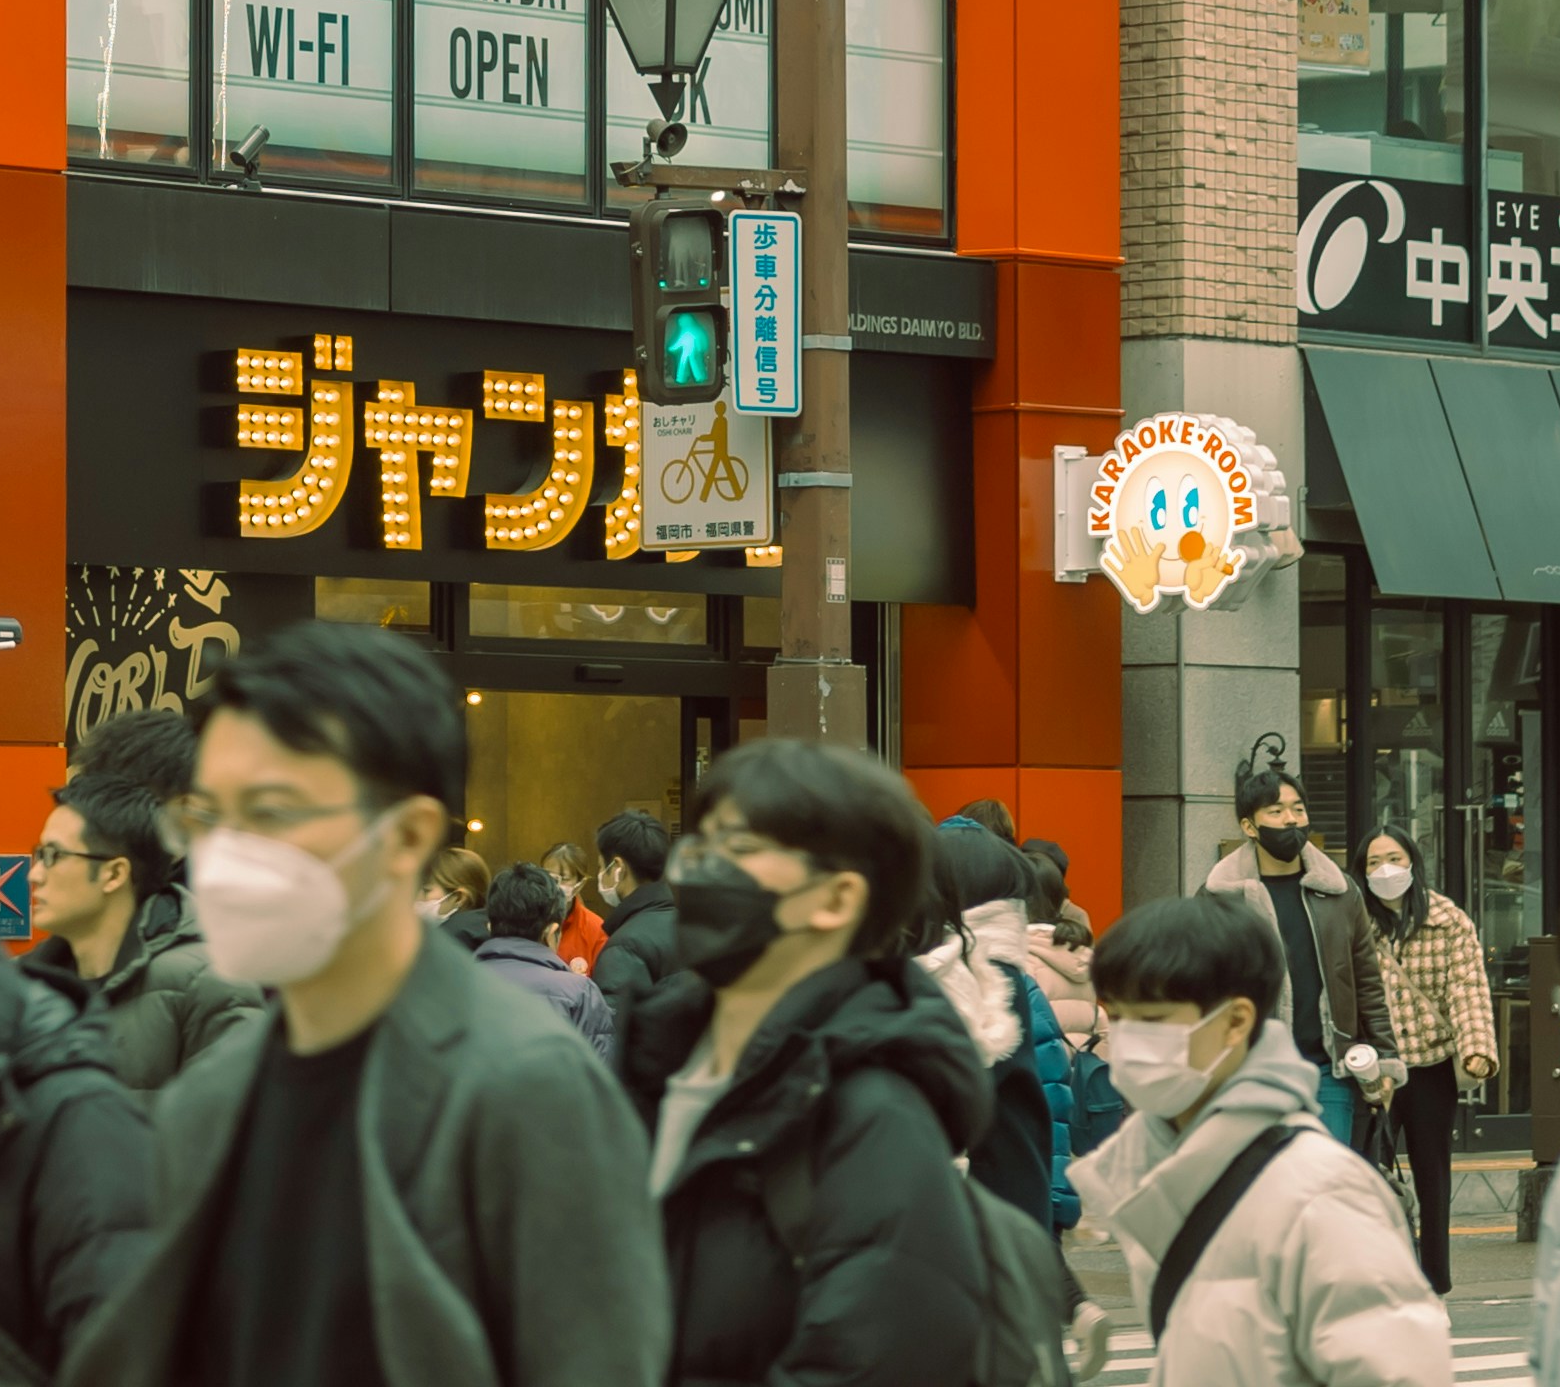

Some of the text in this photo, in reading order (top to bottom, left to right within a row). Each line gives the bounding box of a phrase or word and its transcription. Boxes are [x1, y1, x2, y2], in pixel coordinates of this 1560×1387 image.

[246, 3, 351, 87] WI-FI
[448, 25, 551, 109] OPEN
[1495, 197, 1542, 233] EYE
[753, 222, 779, 405] 歩車分離信号
[901, 317, 955, 339] DAIMYO
[653, 414, 696, 429] おしチャリ
[66, 615, 241, 743] ORLD
